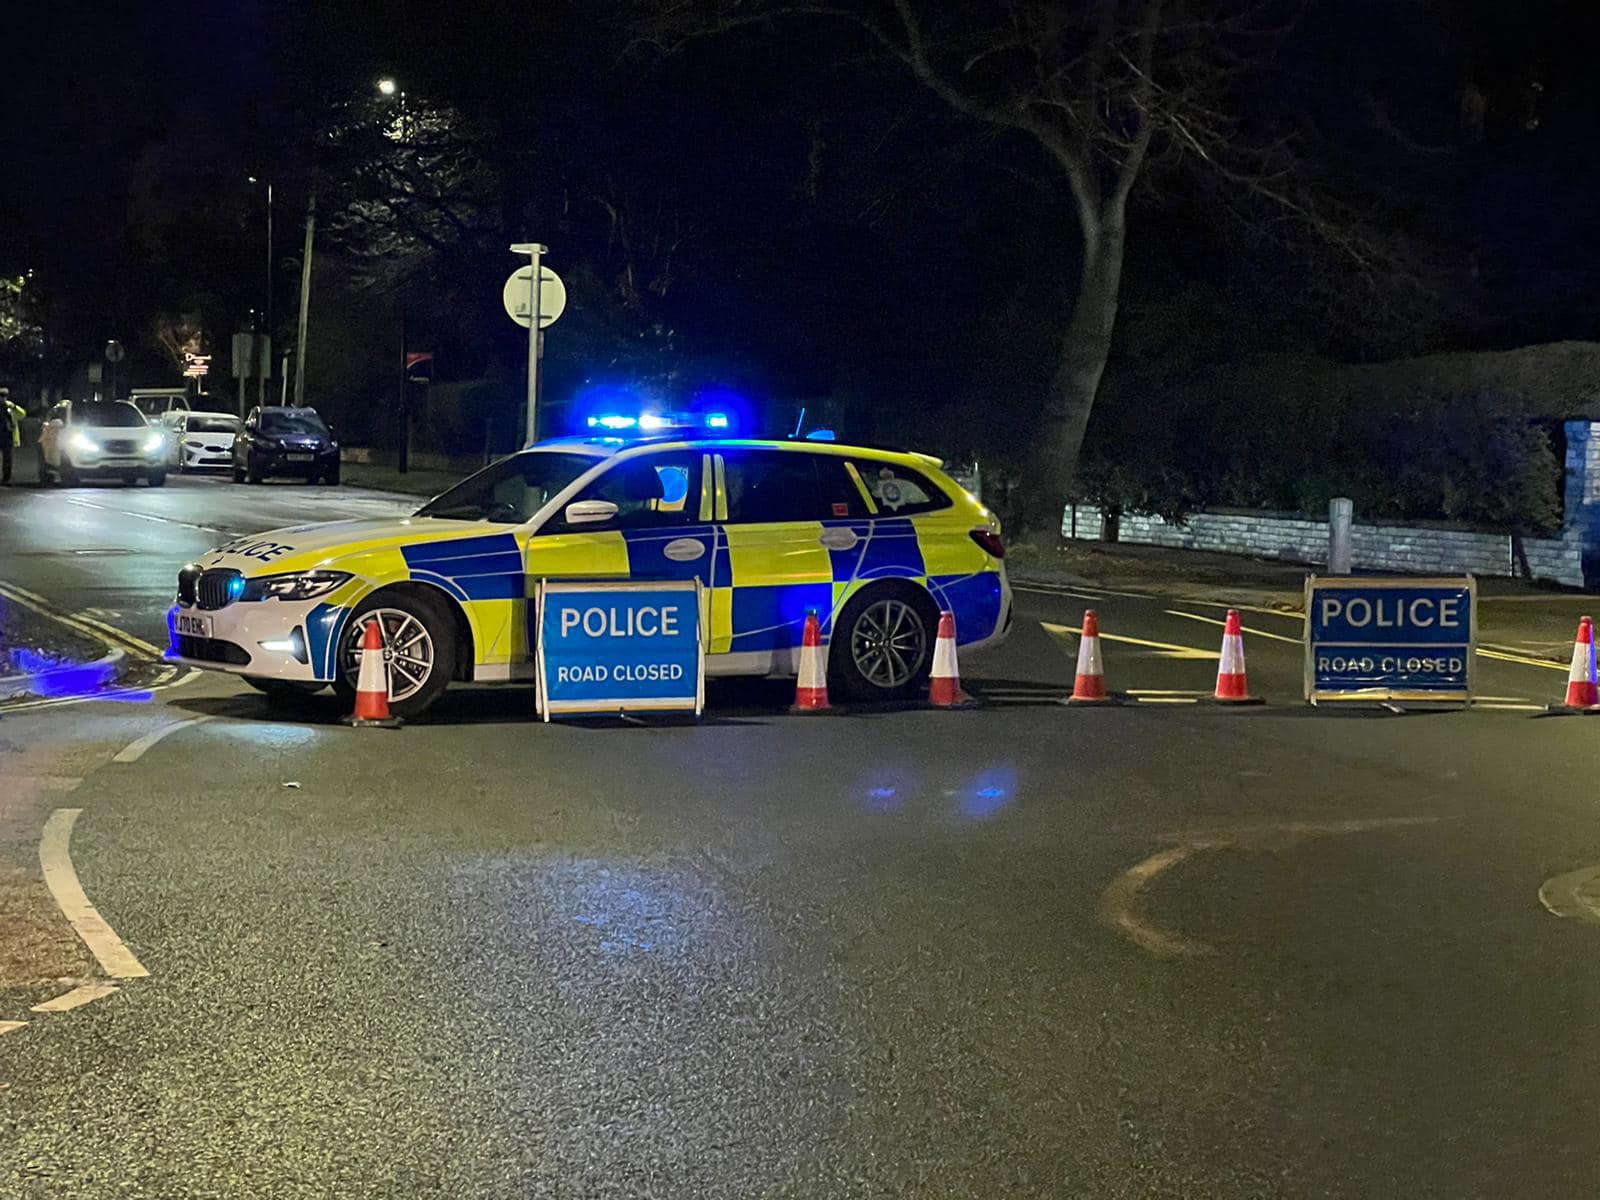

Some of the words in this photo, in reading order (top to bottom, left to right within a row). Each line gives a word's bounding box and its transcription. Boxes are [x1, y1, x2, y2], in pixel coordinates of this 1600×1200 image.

[560, 606, 680, 638] POLICE
[1321, 597, 1460, 628] POLICE
[557, 665, 609, 683] ROAD
[612, 663, 684, 682] CLOSED
[1318, 656, 1375, 673] ROAD
[1381, 656, 1463, 673] CLOSED
